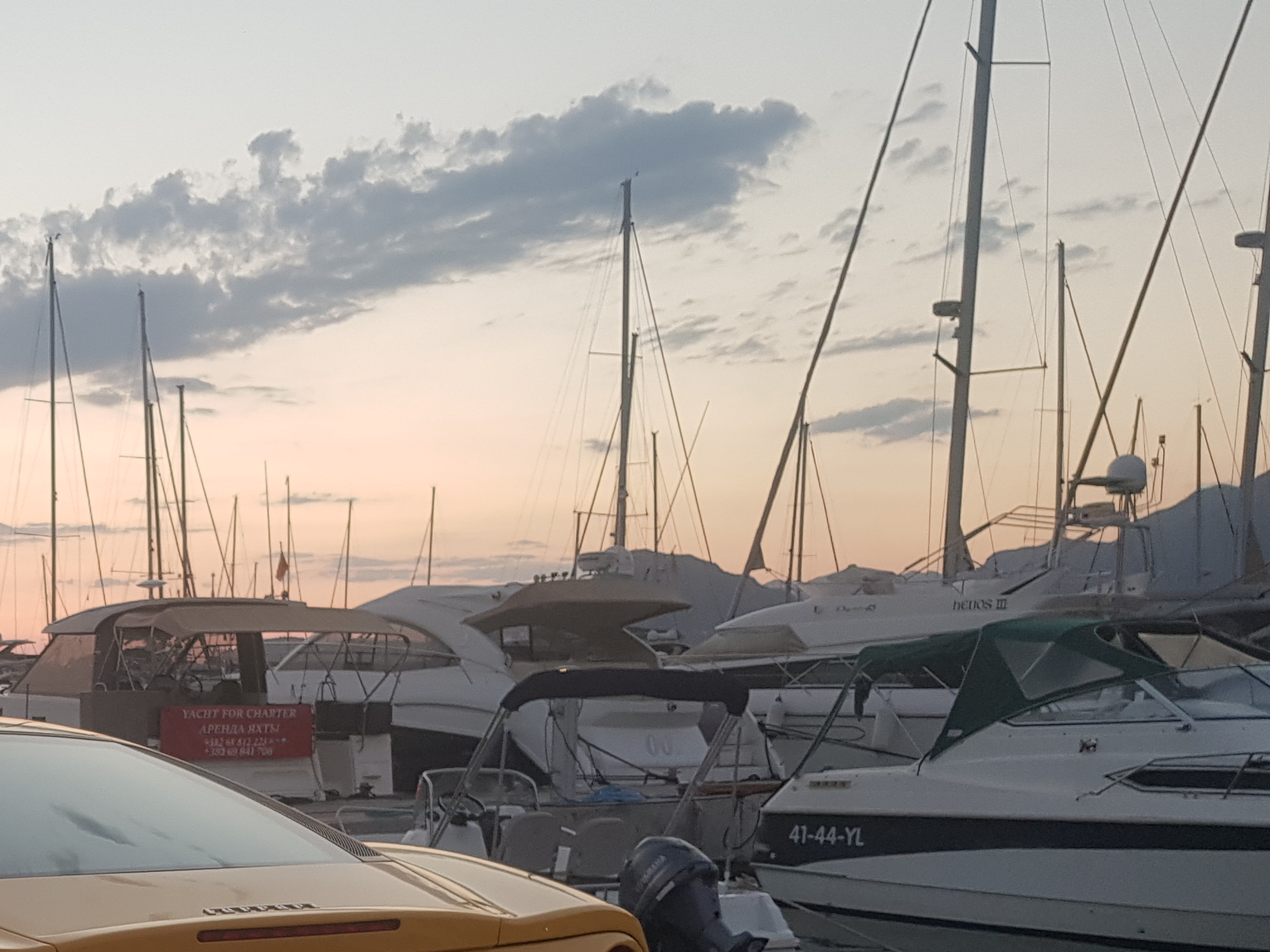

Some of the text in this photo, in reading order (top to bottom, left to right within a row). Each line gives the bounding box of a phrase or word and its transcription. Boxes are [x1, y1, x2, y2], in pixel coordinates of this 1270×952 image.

[182, 708, 297, 719] YACHT FOR CHARTER
[199, 724, 280, 734] АРЕНДА ЯХТЫ
[788, 824, 864, 846] 41-44-YL
